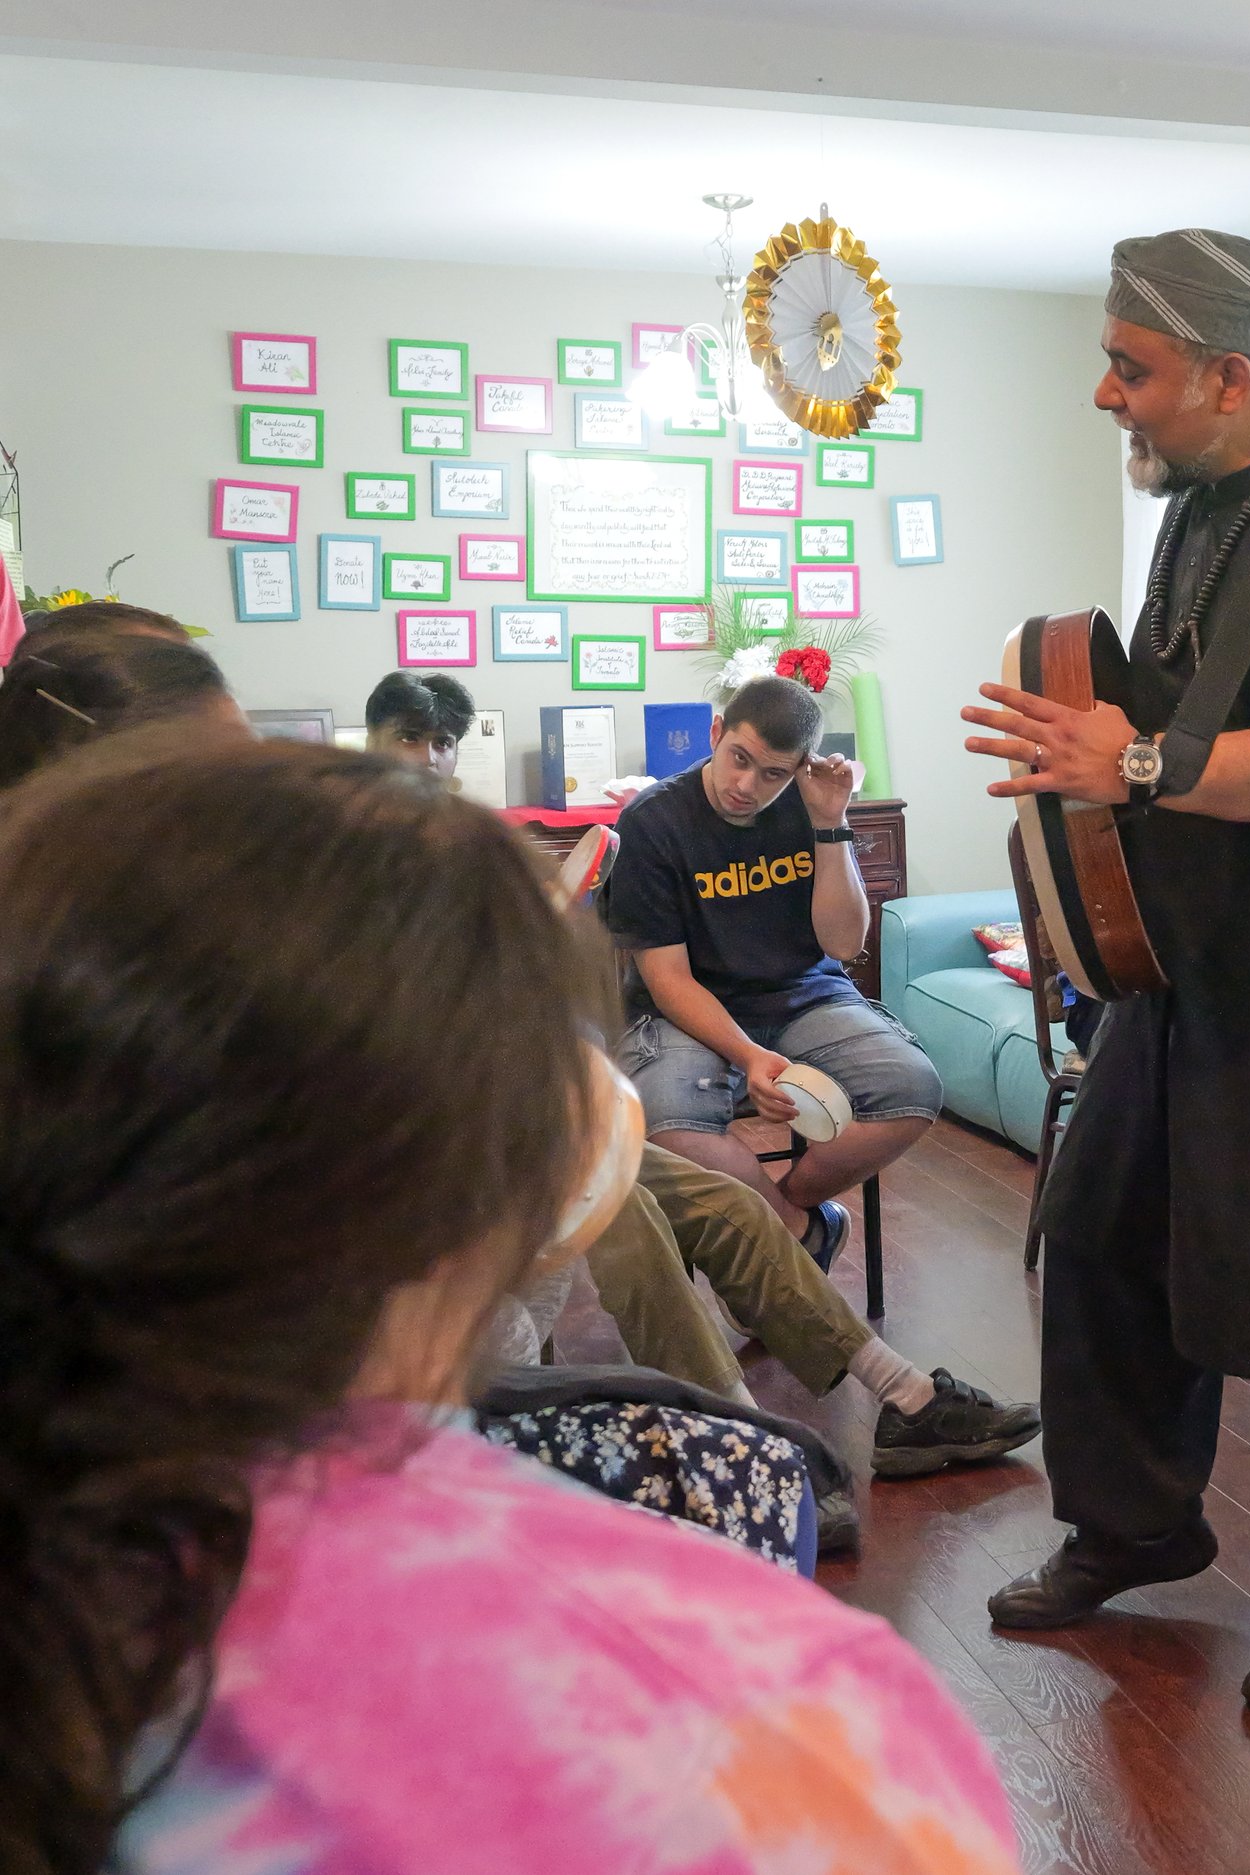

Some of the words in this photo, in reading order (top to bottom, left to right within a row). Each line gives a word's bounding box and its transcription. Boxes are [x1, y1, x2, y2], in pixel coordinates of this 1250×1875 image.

[260, 362, 279, 374] Ali
[870, 419, 895, 430] oronto
[270, 427, 303, 439] Islamic
[262, 438, 294, 448] Centre
[448, 485, 496, 502] Emporium
[335, 554, 364, 567] Donate
[694, 850, 815, 899] adidas
